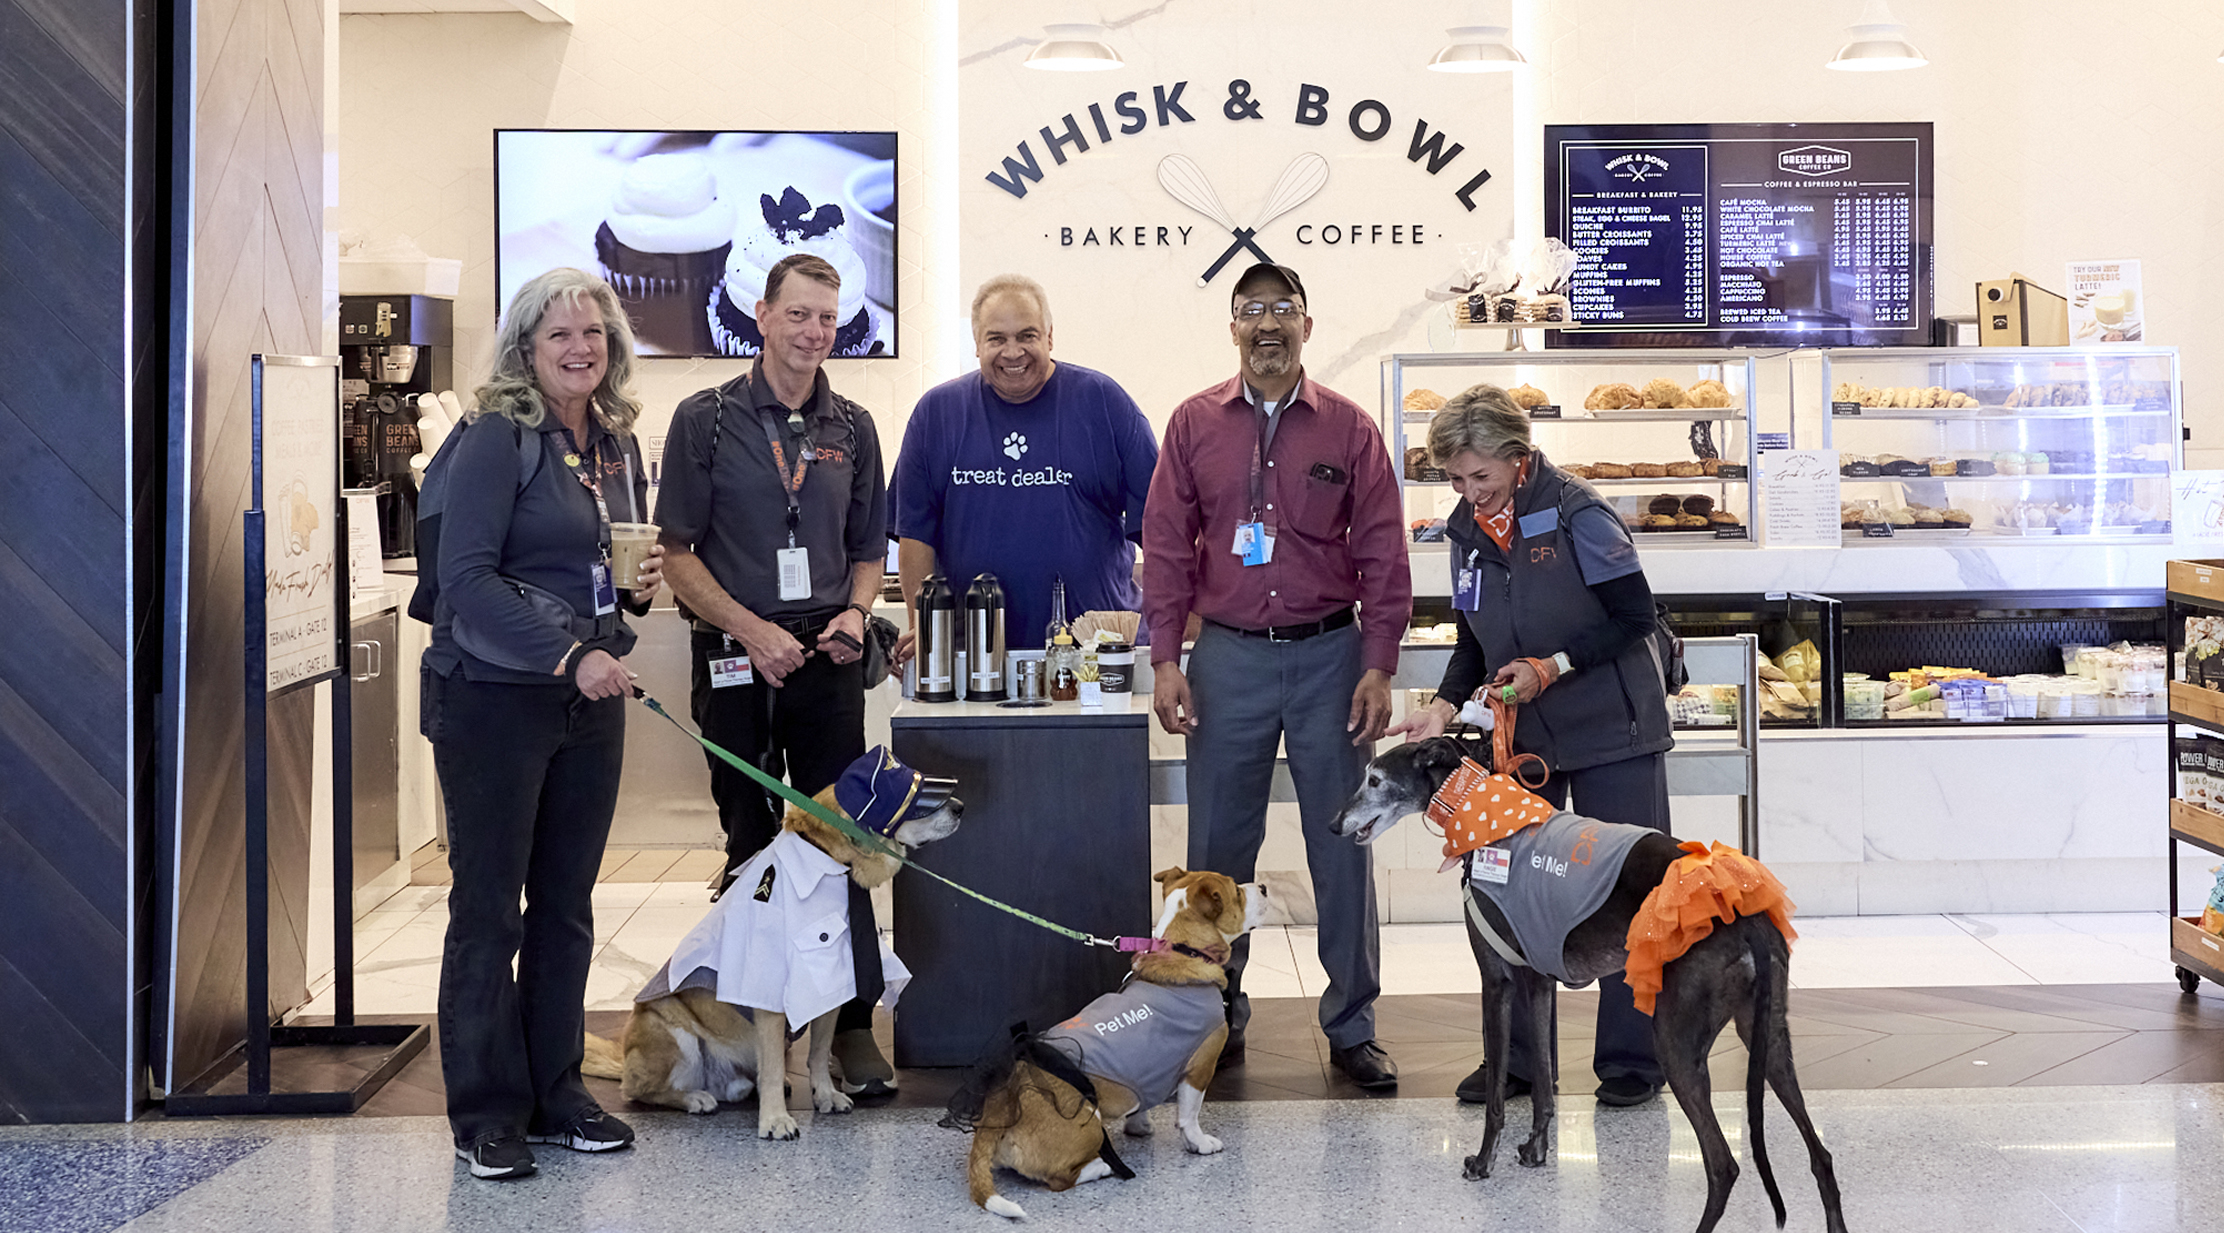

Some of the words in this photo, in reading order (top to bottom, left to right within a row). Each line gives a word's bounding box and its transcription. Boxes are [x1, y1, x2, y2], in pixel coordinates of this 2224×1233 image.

[984, 80, 1196, 200] WHISK
[1223, 78, 1264, 121] &
[1294, 83, 1493, 213] BOWL
[1604, 154, 1633, 170] WHISK
[1644, 154, 1670, 170] BOWL
[1782, 154, 1813, 164] GREEN
[1815, 154, 1847, 164] BEANS
[1061, 226, 1195, 247] BAKERY
[1296, 224, 1425, 246] COFFEE
[2074, 273, 2120, 282] TURMERIC
[816, 448, 844, 463] DFW
[951, 466, 1007, 486] treat
[1011, 466, 1073, 487] dealer
[307, 620, 320, 636] GATE
[307, 656, 320, 673] GATE
[1094, 1016, 1125, 1036] Pet
[1122, 1003, 1154, 1026] Me!
